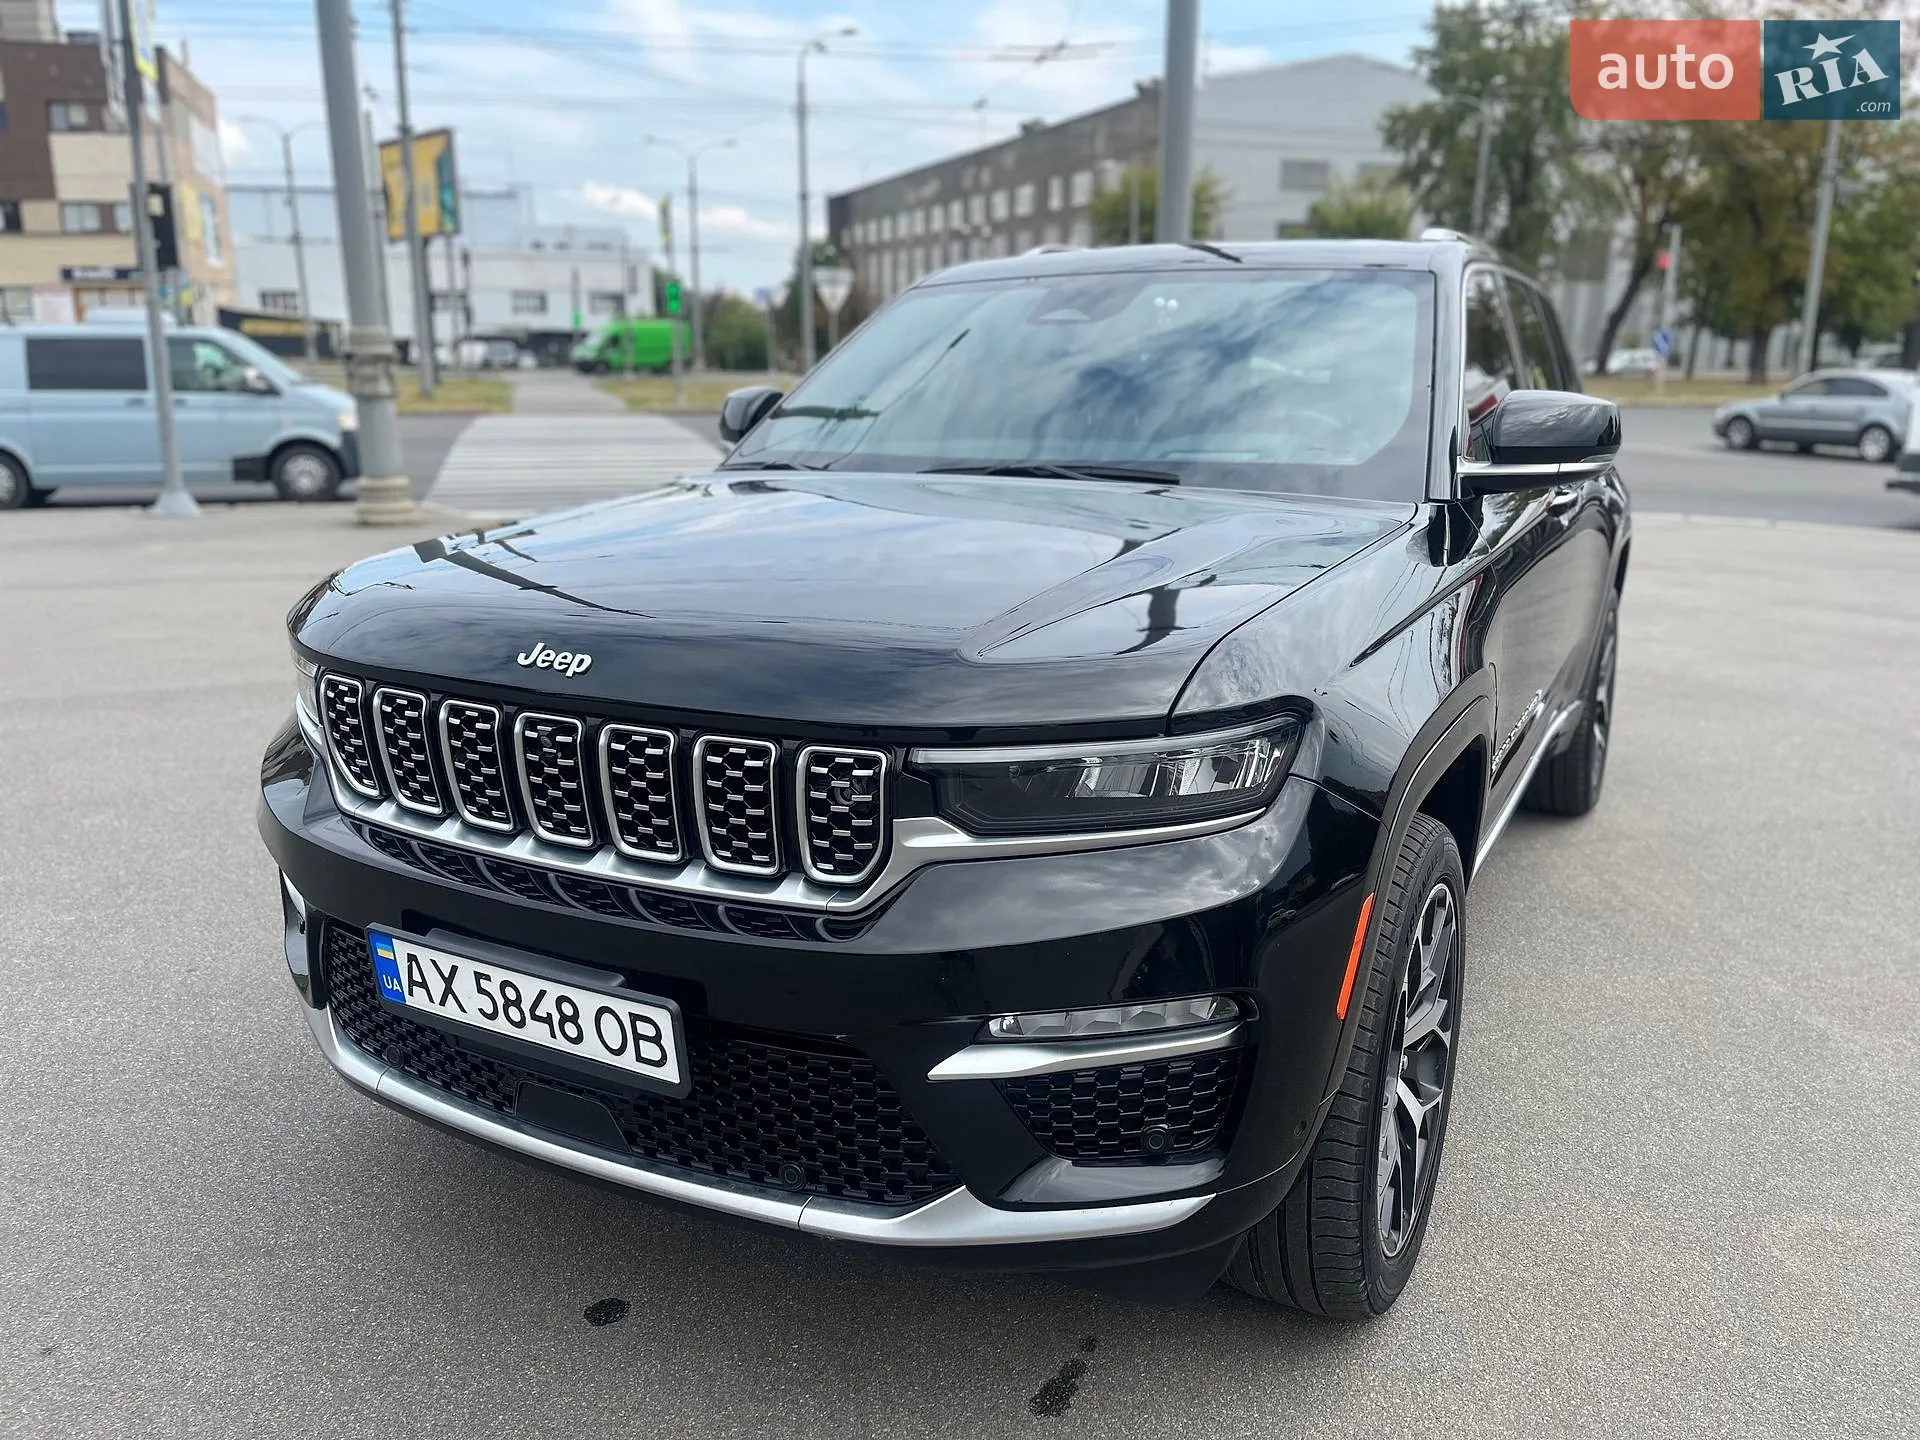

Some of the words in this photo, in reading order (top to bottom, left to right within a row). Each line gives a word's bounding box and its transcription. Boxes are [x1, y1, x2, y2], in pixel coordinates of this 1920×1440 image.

[516, 642, 593, 678] Jeep
[382, 974, 403, 993] UA
[406, 952, 468, 1015] AX
[473, 969, 585, 1047] 5848
[594, 1004, 668, 1069] OB
